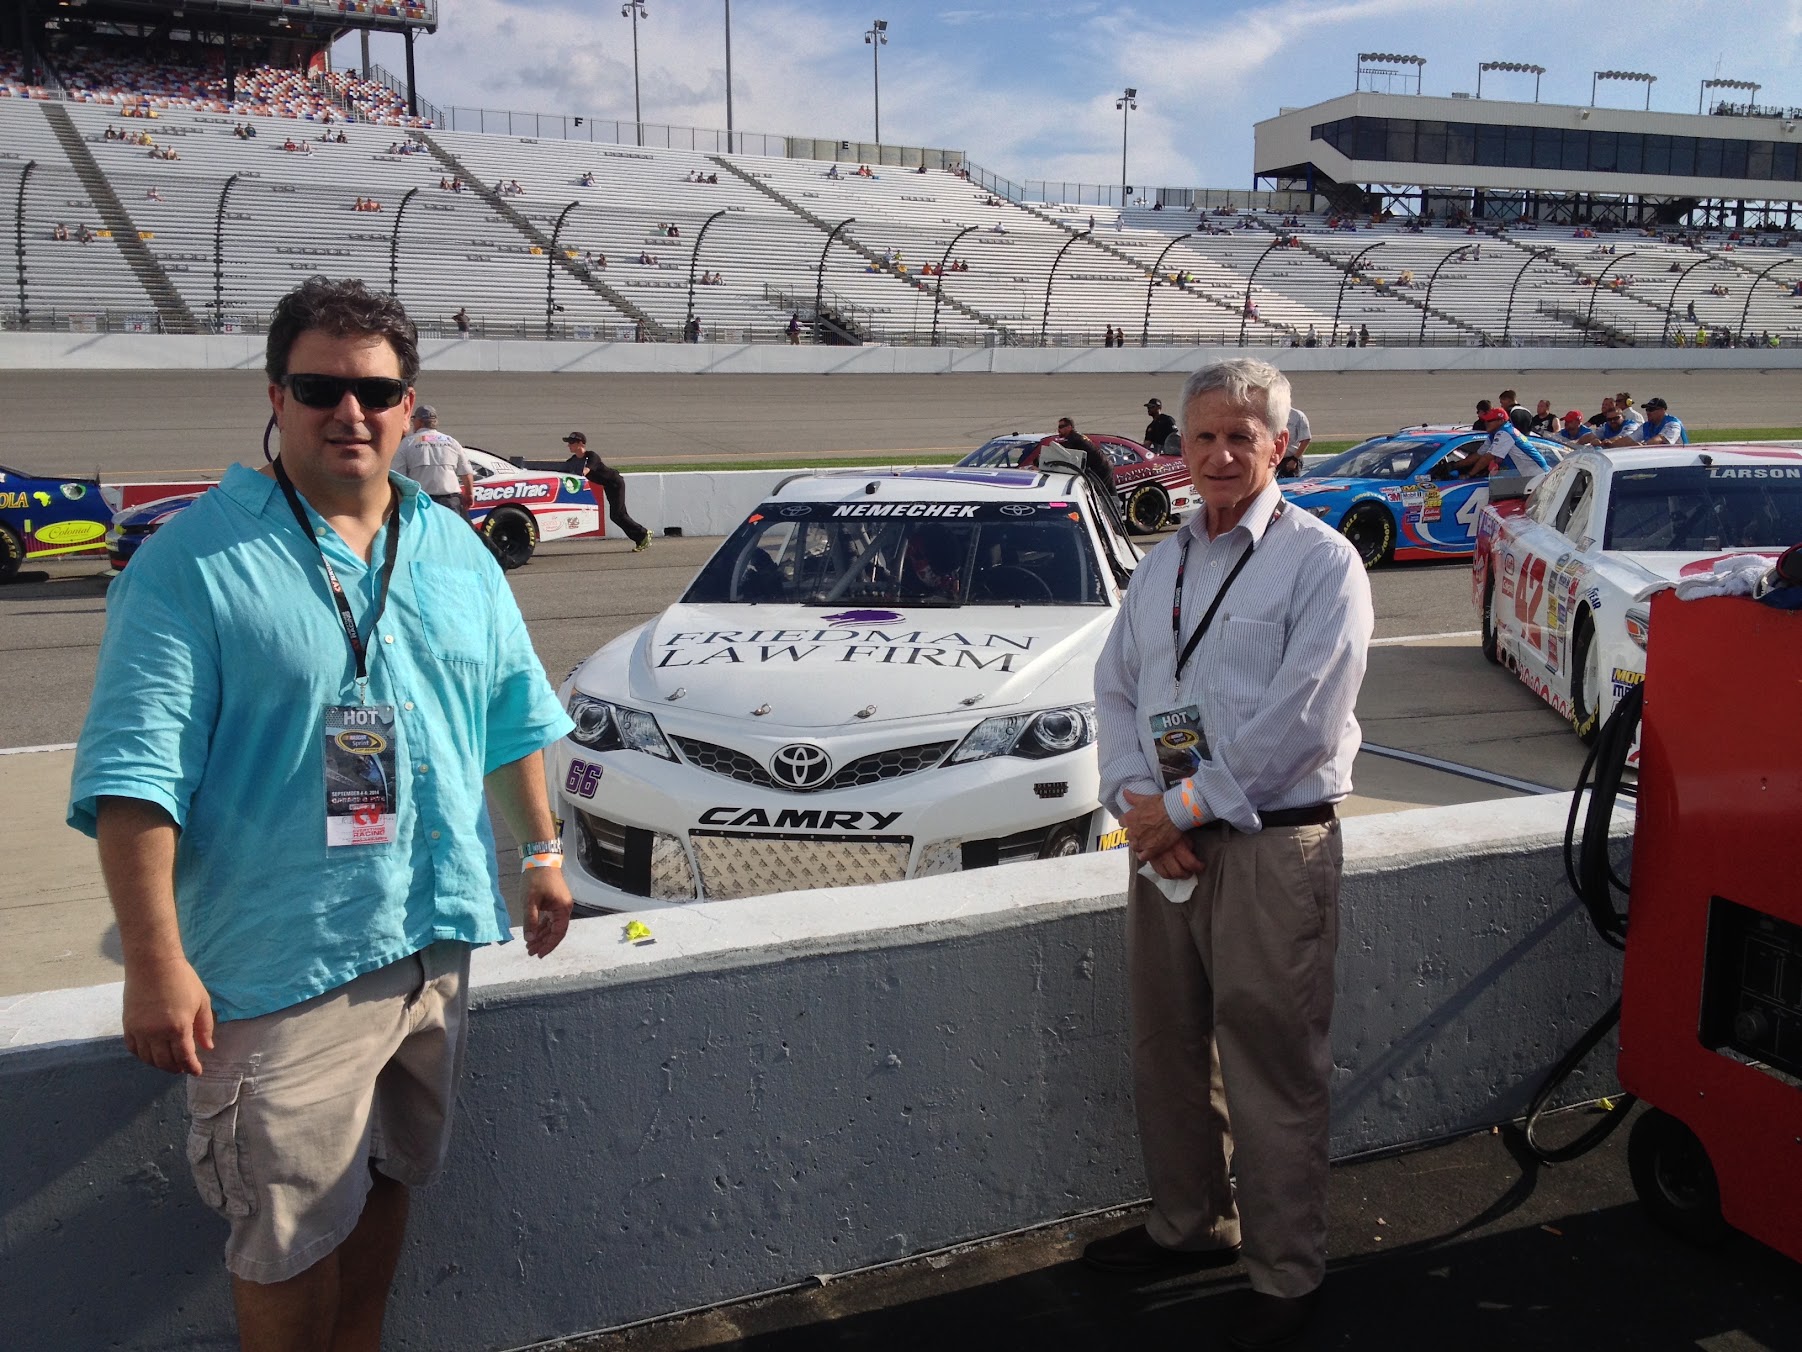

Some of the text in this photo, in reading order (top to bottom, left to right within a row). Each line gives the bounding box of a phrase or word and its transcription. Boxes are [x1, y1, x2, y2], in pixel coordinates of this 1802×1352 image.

[574, 117, 583, 127] F
[842, 141, 849, 150] E
[1126, 186, 1133, 195] D
[1709, 468, 1801, 479] LARSON
[473, 482, 548, 501] RaceTrac
[832, 504, 980, 518] NEMECHEK
[48, 525, 92, 539] Colonial
[1515, 552, 1547, 651] 42
[659, 630, 1039, 650] FRIEDMAN
[655, 645, 1020, 673] LAW FIRM
[343, 711, 379, 726] HOT
[1162, 712, 1188, 728] HOT
[566, 758, 603, 799] 66
[698, 807, 904, 830] CAMRY
